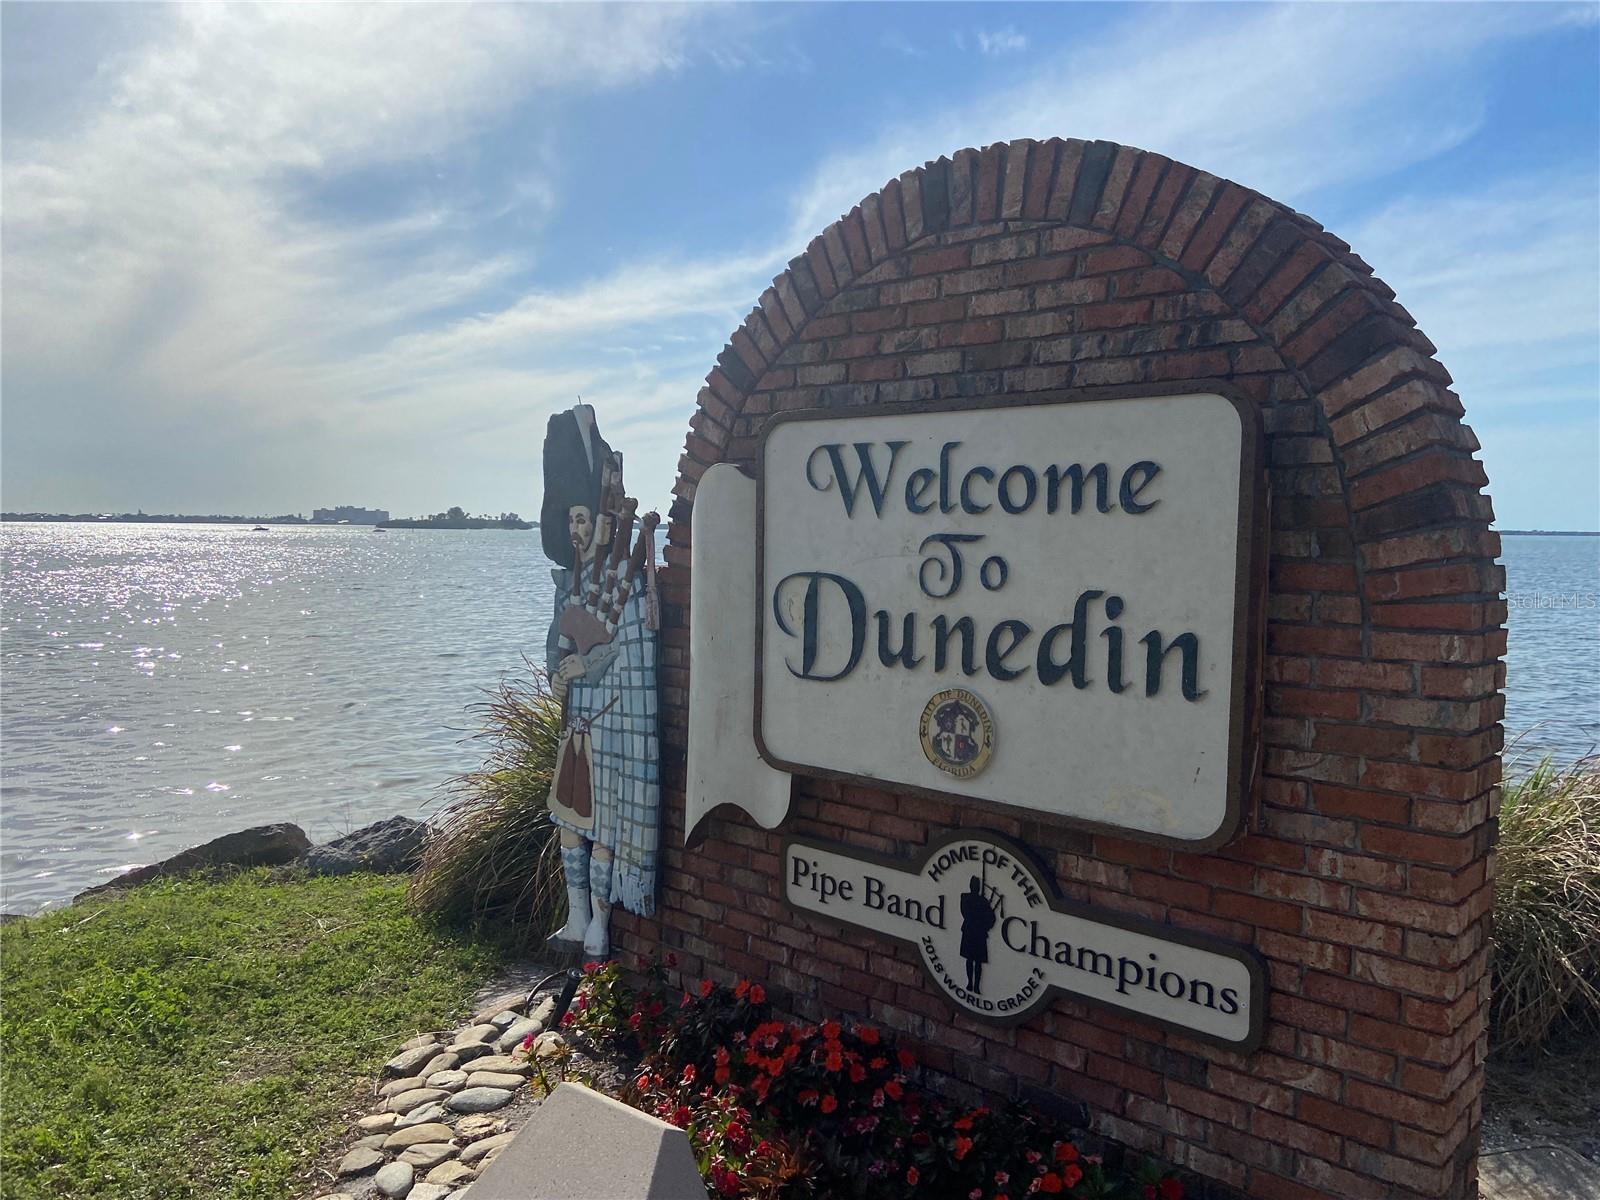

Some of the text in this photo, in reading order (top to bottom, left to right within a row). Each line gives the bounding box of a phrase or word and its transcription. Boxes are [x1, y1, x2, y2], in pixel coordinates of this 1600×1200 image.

[806, 441, 1162, 519] Welcome
[918, 533, 1009, 598] To
[773, 571, 1209, 702] Dunedin
[922, 691, 993, 734] CITY OF DUNEDIN
[927, 845, 1044, 908] HOME OF THE
[791, 856, 1239, 1015] Pipe Band Champions
[921, 935, 1046, 1012] 2018 WORLD GRADE 2
